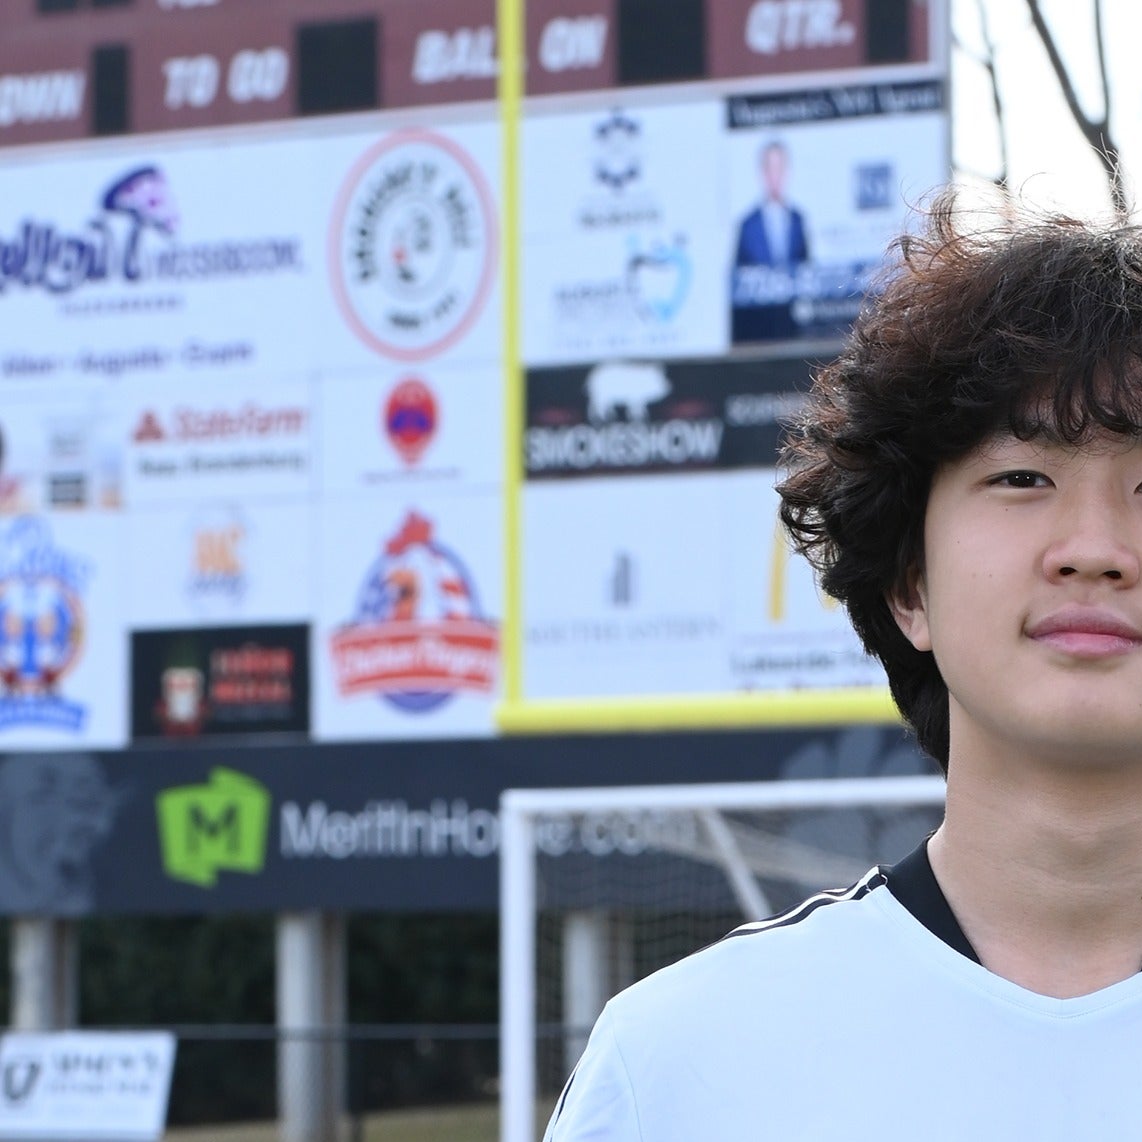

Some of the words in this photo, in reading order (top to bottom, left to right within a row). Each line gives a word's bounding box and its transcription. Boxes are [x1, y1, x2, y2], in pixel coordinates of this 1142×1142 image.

[412, 26, 524, 84] BAL
[538, 14, 609, 71] ON
[745, 0, 856, 55] QTR.
[162, 54, 220, 108] TO
[227, 46, 290, 101] GO
